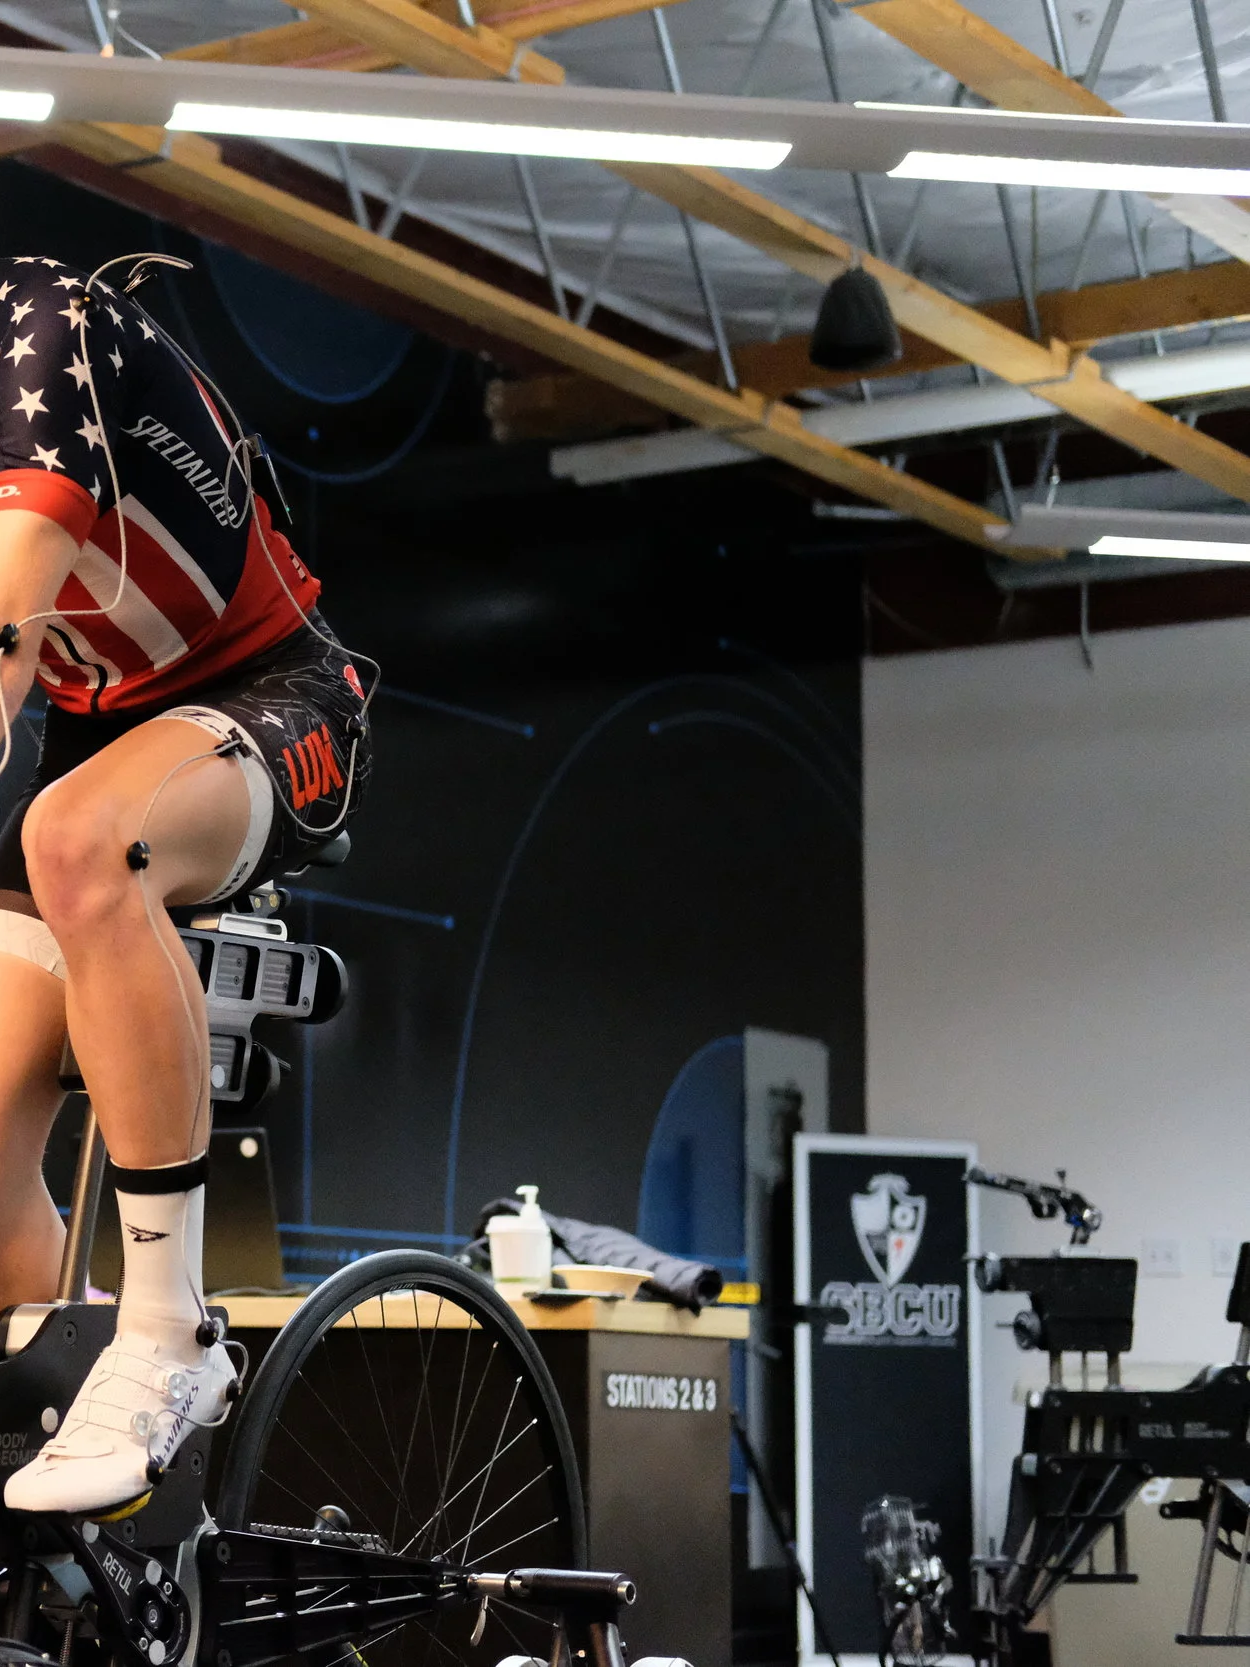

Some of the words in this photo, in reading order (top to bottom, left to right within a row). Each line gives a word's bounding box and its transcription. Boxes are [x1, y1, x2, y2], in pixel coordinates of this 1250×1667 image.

[120, 415, 239, 527] SPECIALIZED
[282, 723, 344, 810] LUX
[607, 1374, 678, 1410] STATIONS
[679, 1377, 691, 1411] 2
[692, 1378, 704, 1411] &
[706, 1379, 717, 1412] 3
[102, 1551, 132, 1596] RETÜL
